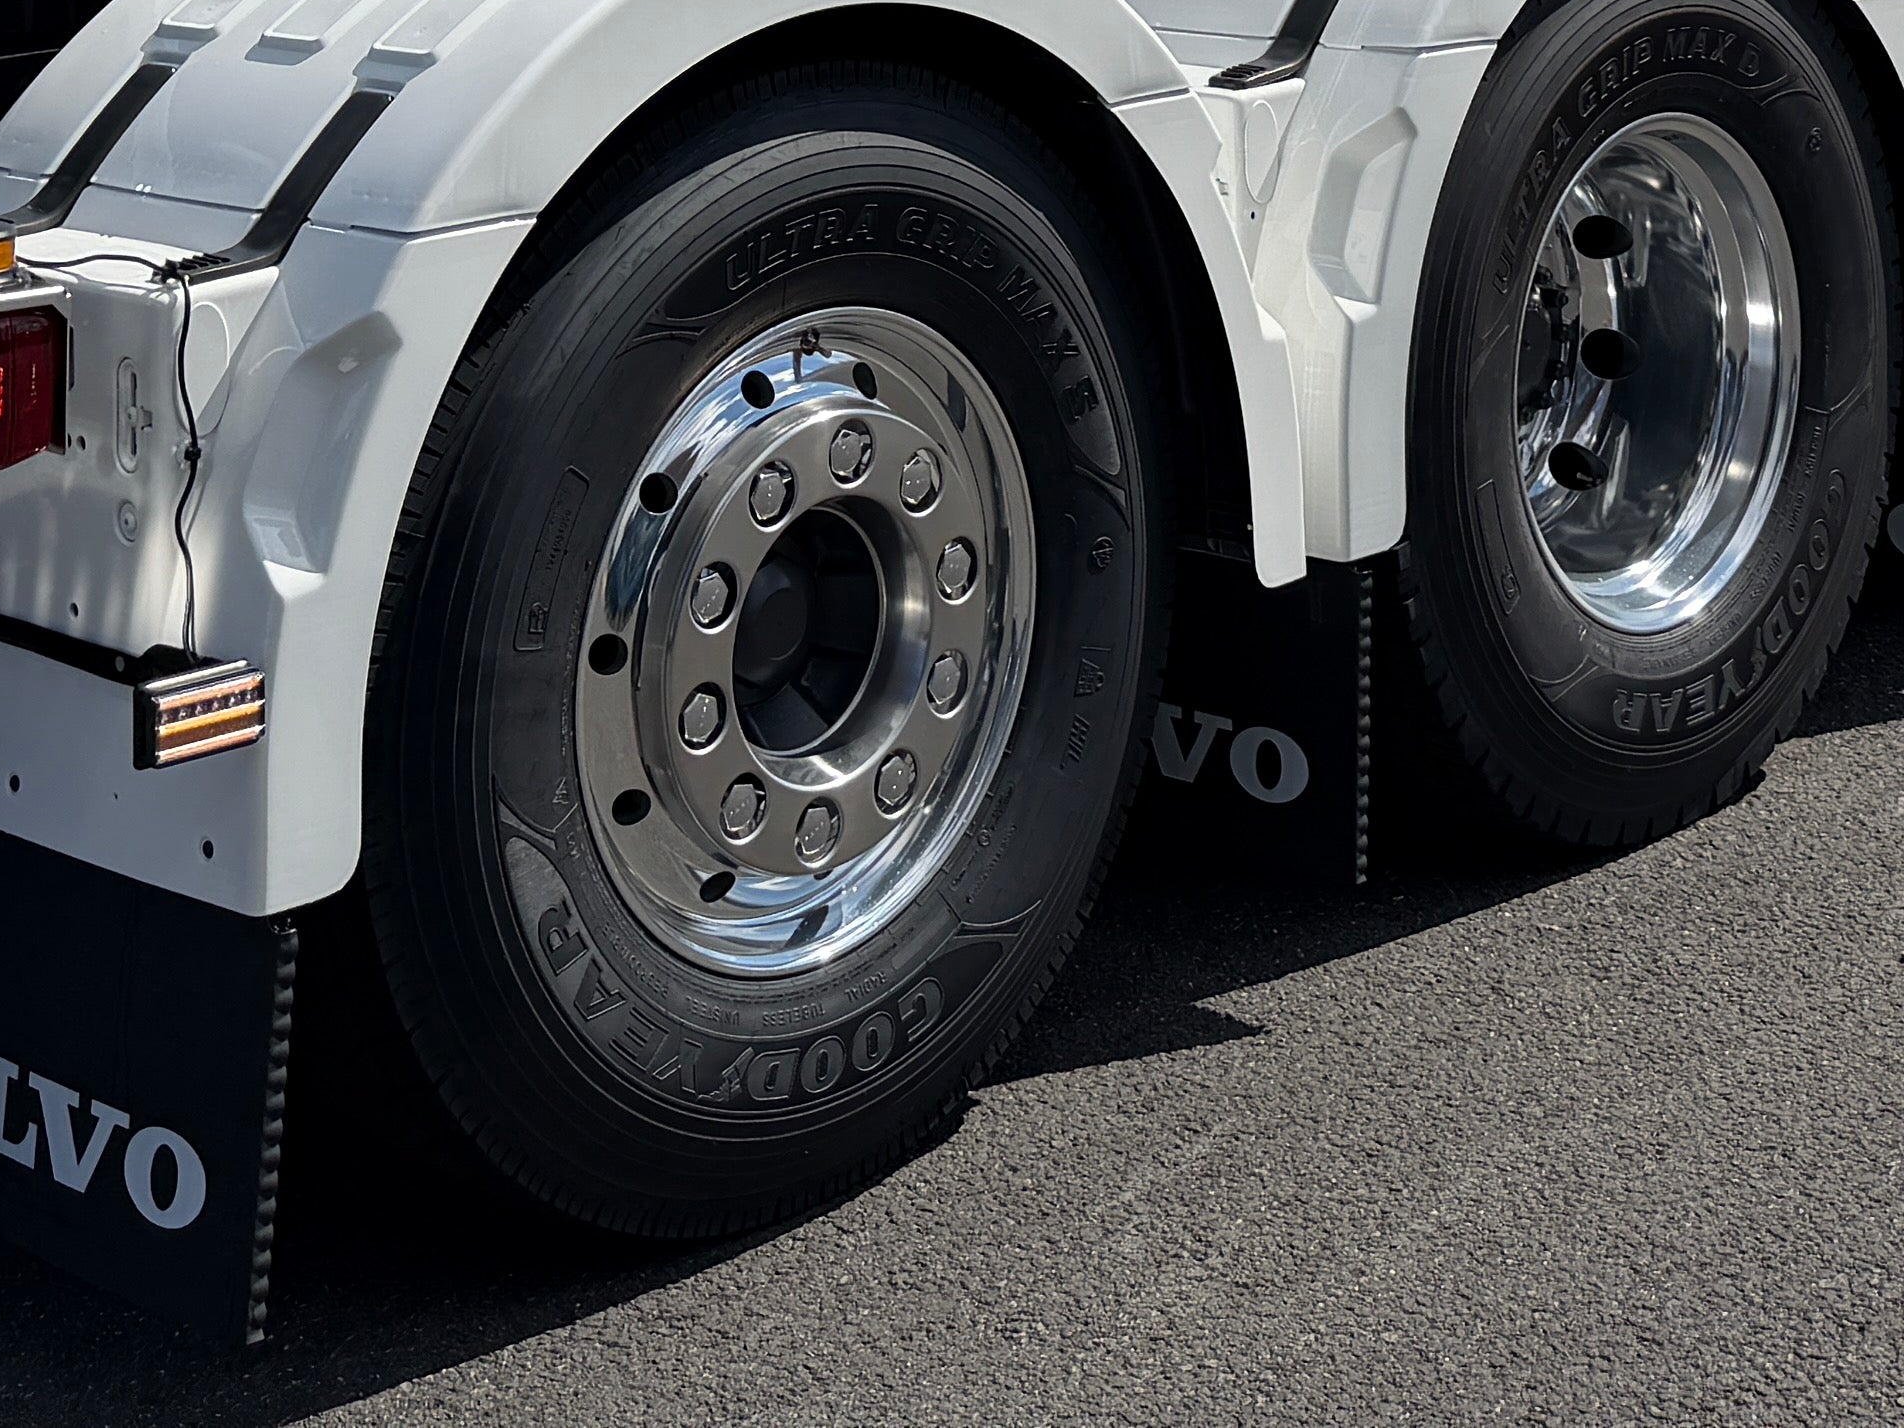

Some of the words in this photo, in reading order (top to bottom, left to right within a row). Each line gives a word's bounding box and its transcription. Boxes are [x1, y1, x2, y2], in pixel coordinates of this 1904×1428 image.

[1492, 116, 1572, 296] ULTRA
[1577, 36, 1653, 119] GRIP
[1661, 25, 1737, 66] MAX
[725, 202, 880, 292] ULTRA
[895, 206, 1000, 271] GRIP
[996, 264, 1082, 371] MAX
[1611, 466, 1848, 734] GOODYEAR
[537, 898, 945, 1104] GOODYEAR
